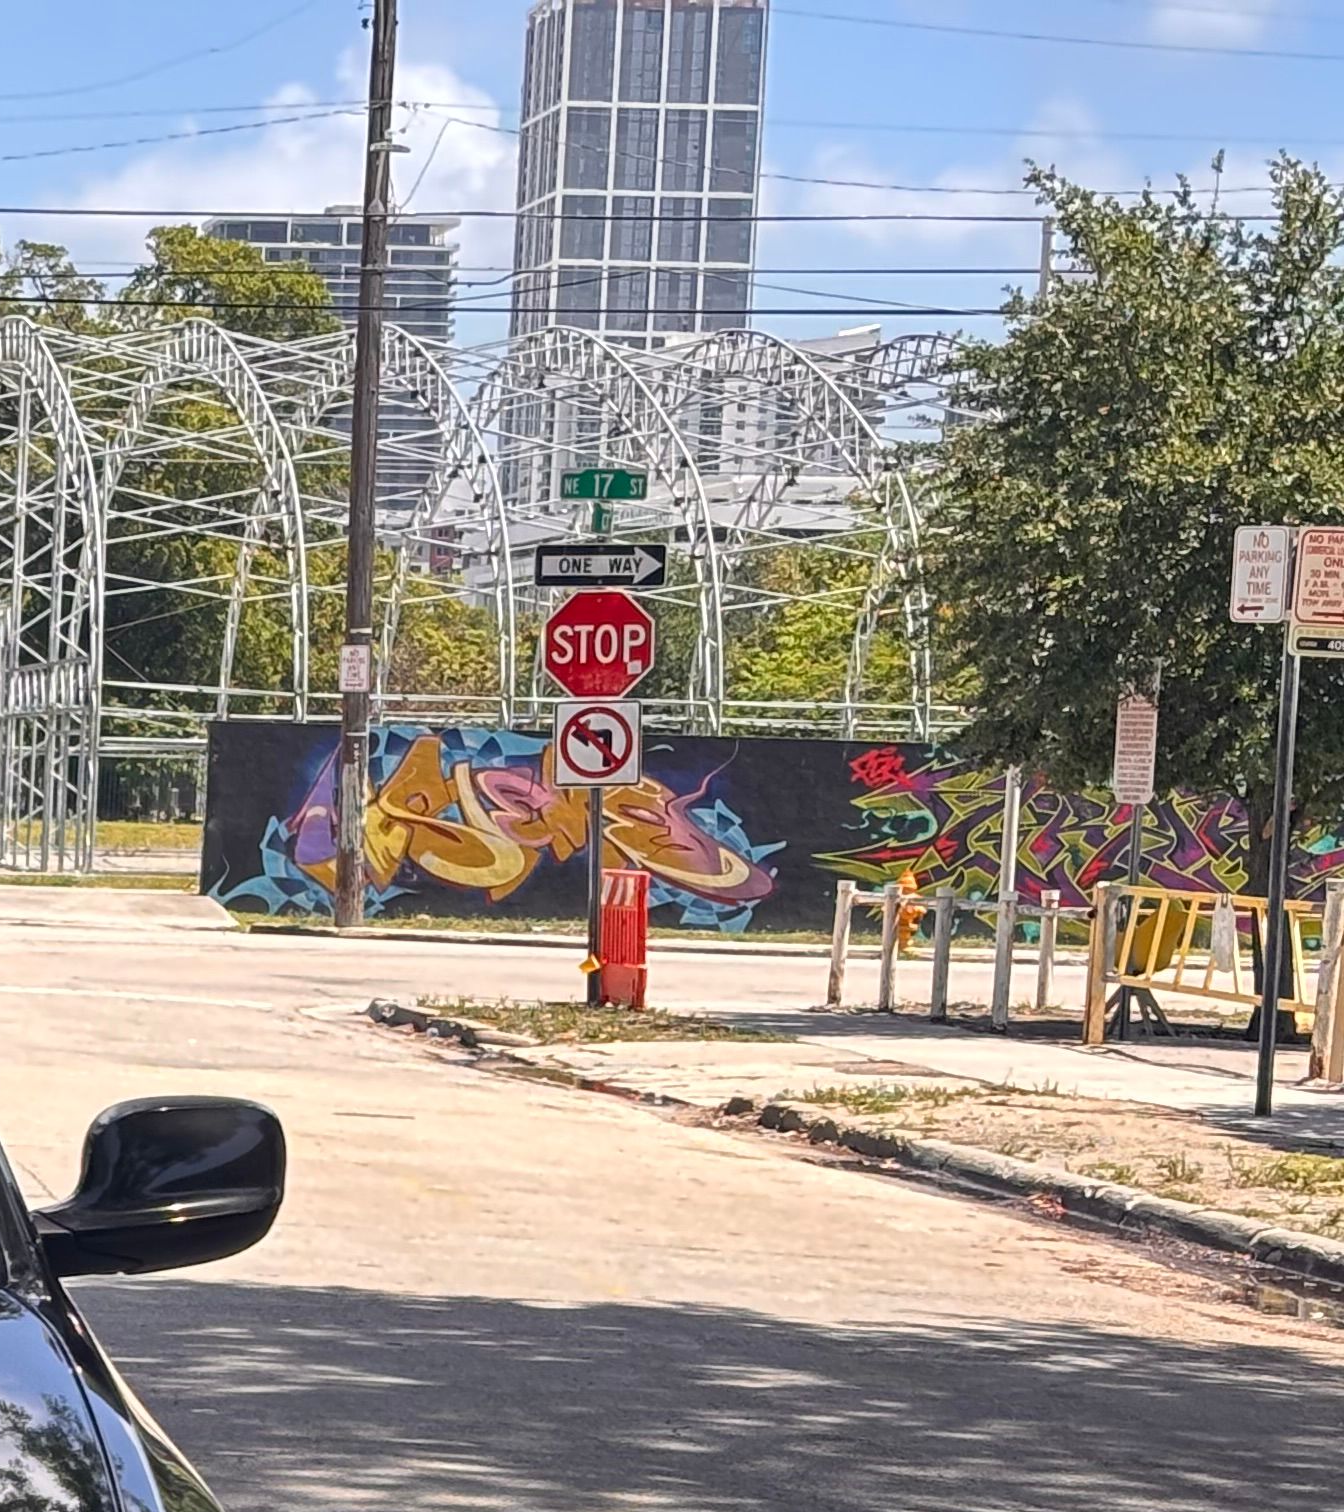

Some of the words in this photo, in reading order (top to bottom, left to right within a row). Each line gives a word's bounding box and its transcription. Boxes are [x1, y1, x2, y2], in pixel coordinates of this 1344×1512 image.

[564, 478, 579, 494] NE
[593, 474, 615, 498] 17
[630, 478, 645, 495] ST
[1253, 533, 1269, 548] NO
[1309, 534, 1324, 545] NO
[1238, 550, 1282, 564] PARKING
[558, 557, 593, 574] ONE
[608, 557, 644, 574] WAY
[1248, 565, 1271, 579] ANY
[1247, 581, 1272, 595] TIME
[551, 623, 647, 665] STOP
